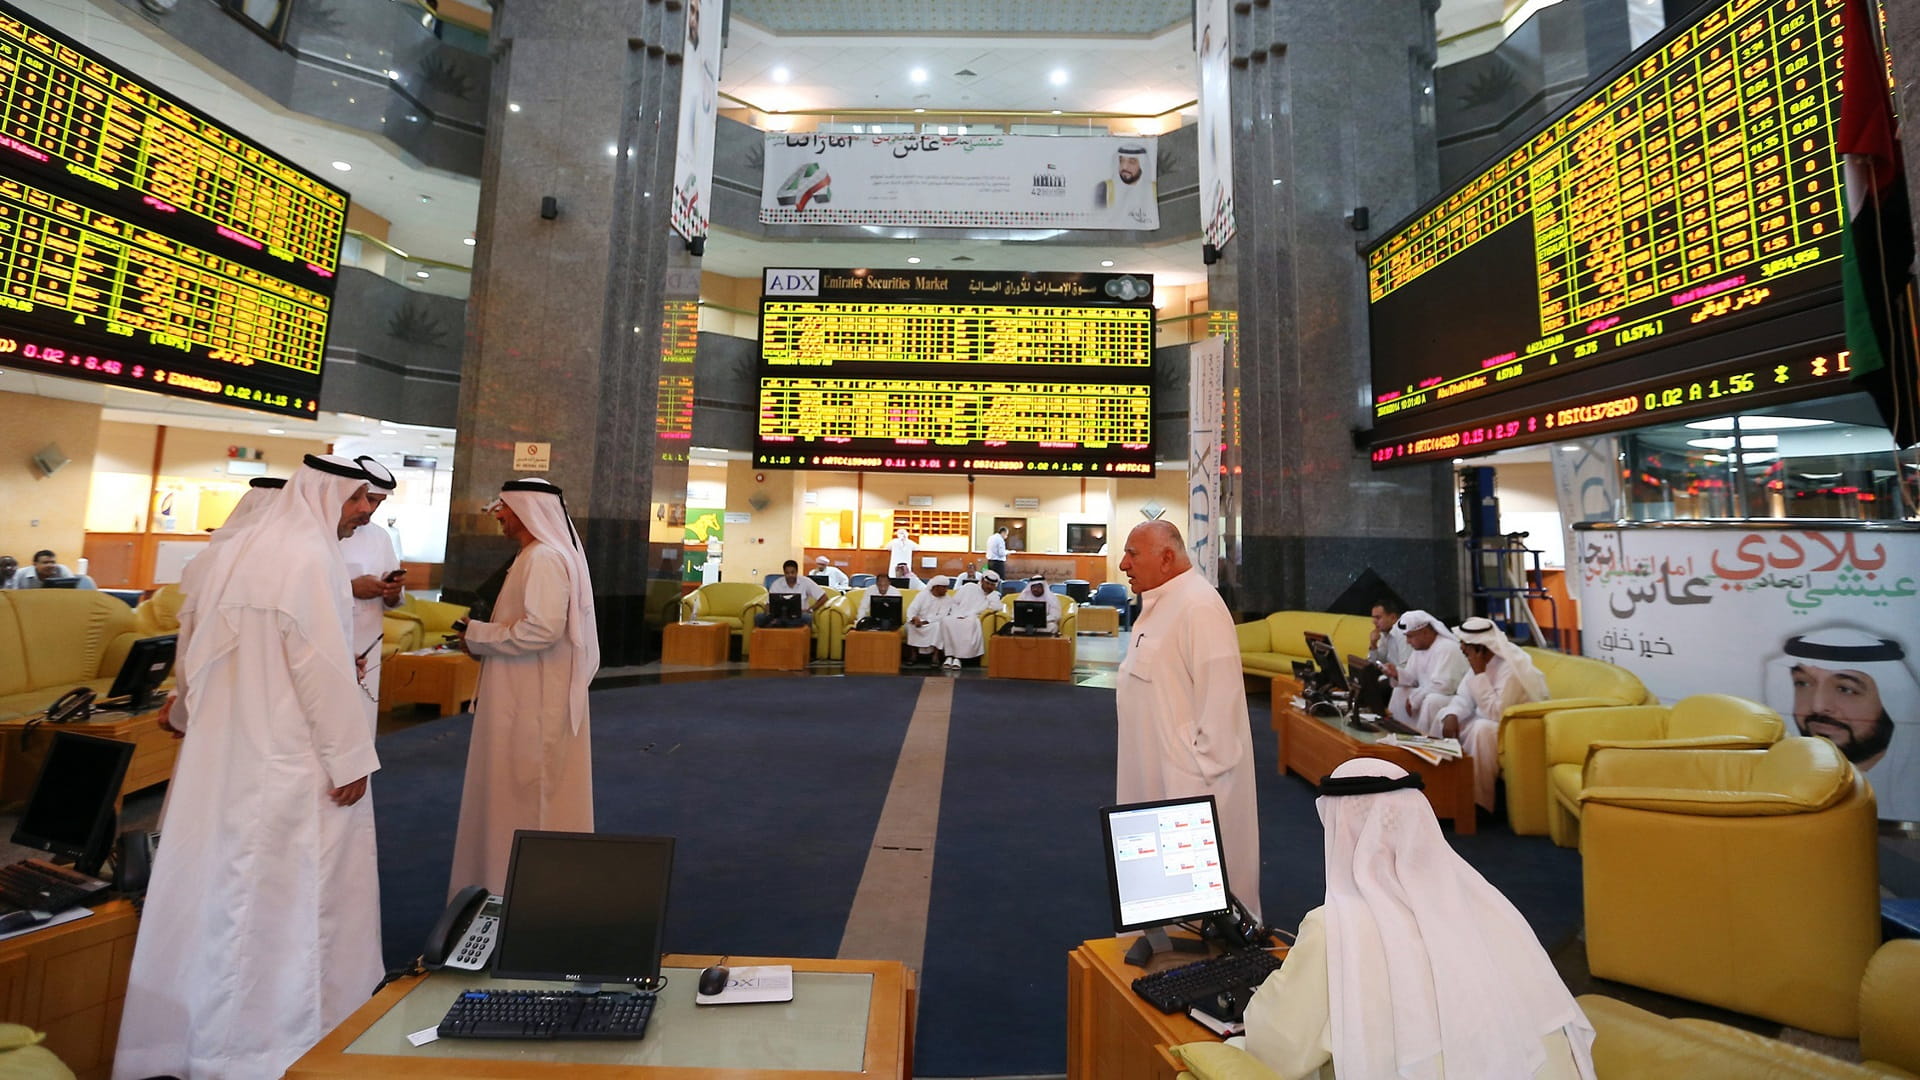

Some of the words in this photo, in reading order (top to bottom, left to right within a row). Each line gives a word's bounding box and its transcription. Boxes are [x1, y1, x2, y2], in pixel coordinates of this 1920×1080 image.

[770, 275, 816, 291] ADX
[823, 275, 863, 289] Emirates
[867, 275, 911, 291] Securities
[915, 276, 948, 291] Market
[968, 278, 1001, 295] المالية
[1072, 278, 1097, 296] سوق
[23, 343, 65, 364] 0.02
[1494, 420, 1520, 439] 2.97
[1645, 388, 1683, 410] 0.02
[1708, 372, 1755, 398] 1.56
[1711, 531, 1887, 593] بلادي
[1786, 564, 1917, 616] عيشي
